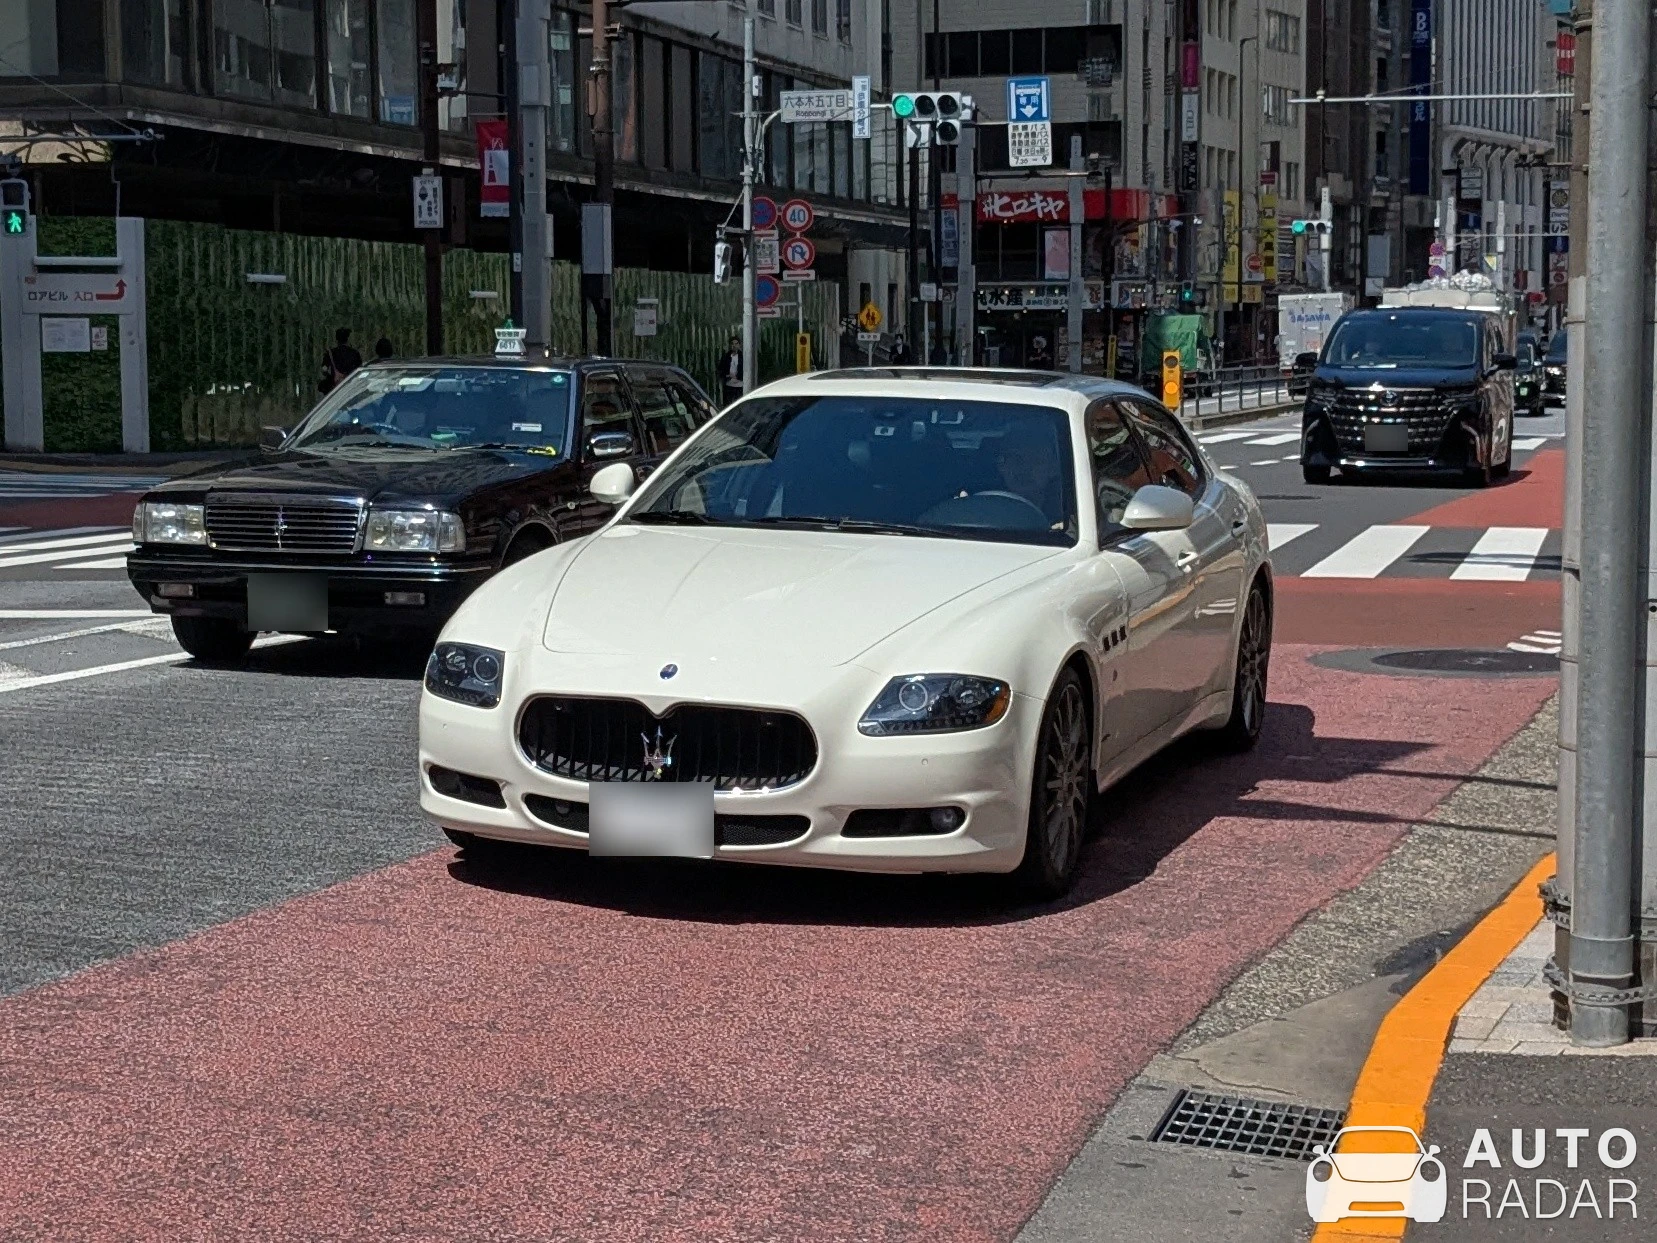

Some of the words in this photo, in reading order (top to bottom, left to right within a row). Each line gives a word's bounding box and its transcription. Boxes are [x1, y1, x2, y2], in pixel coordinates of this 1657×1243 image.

[785, 94, 845, 108] 六本木五丁目
[789, 208, 806, 223] 40
[28, 291, 69, 301] ロアビル
[74, 291, 94, 301] 入口
[1290, 313, 1331, 323] SAGAWA
